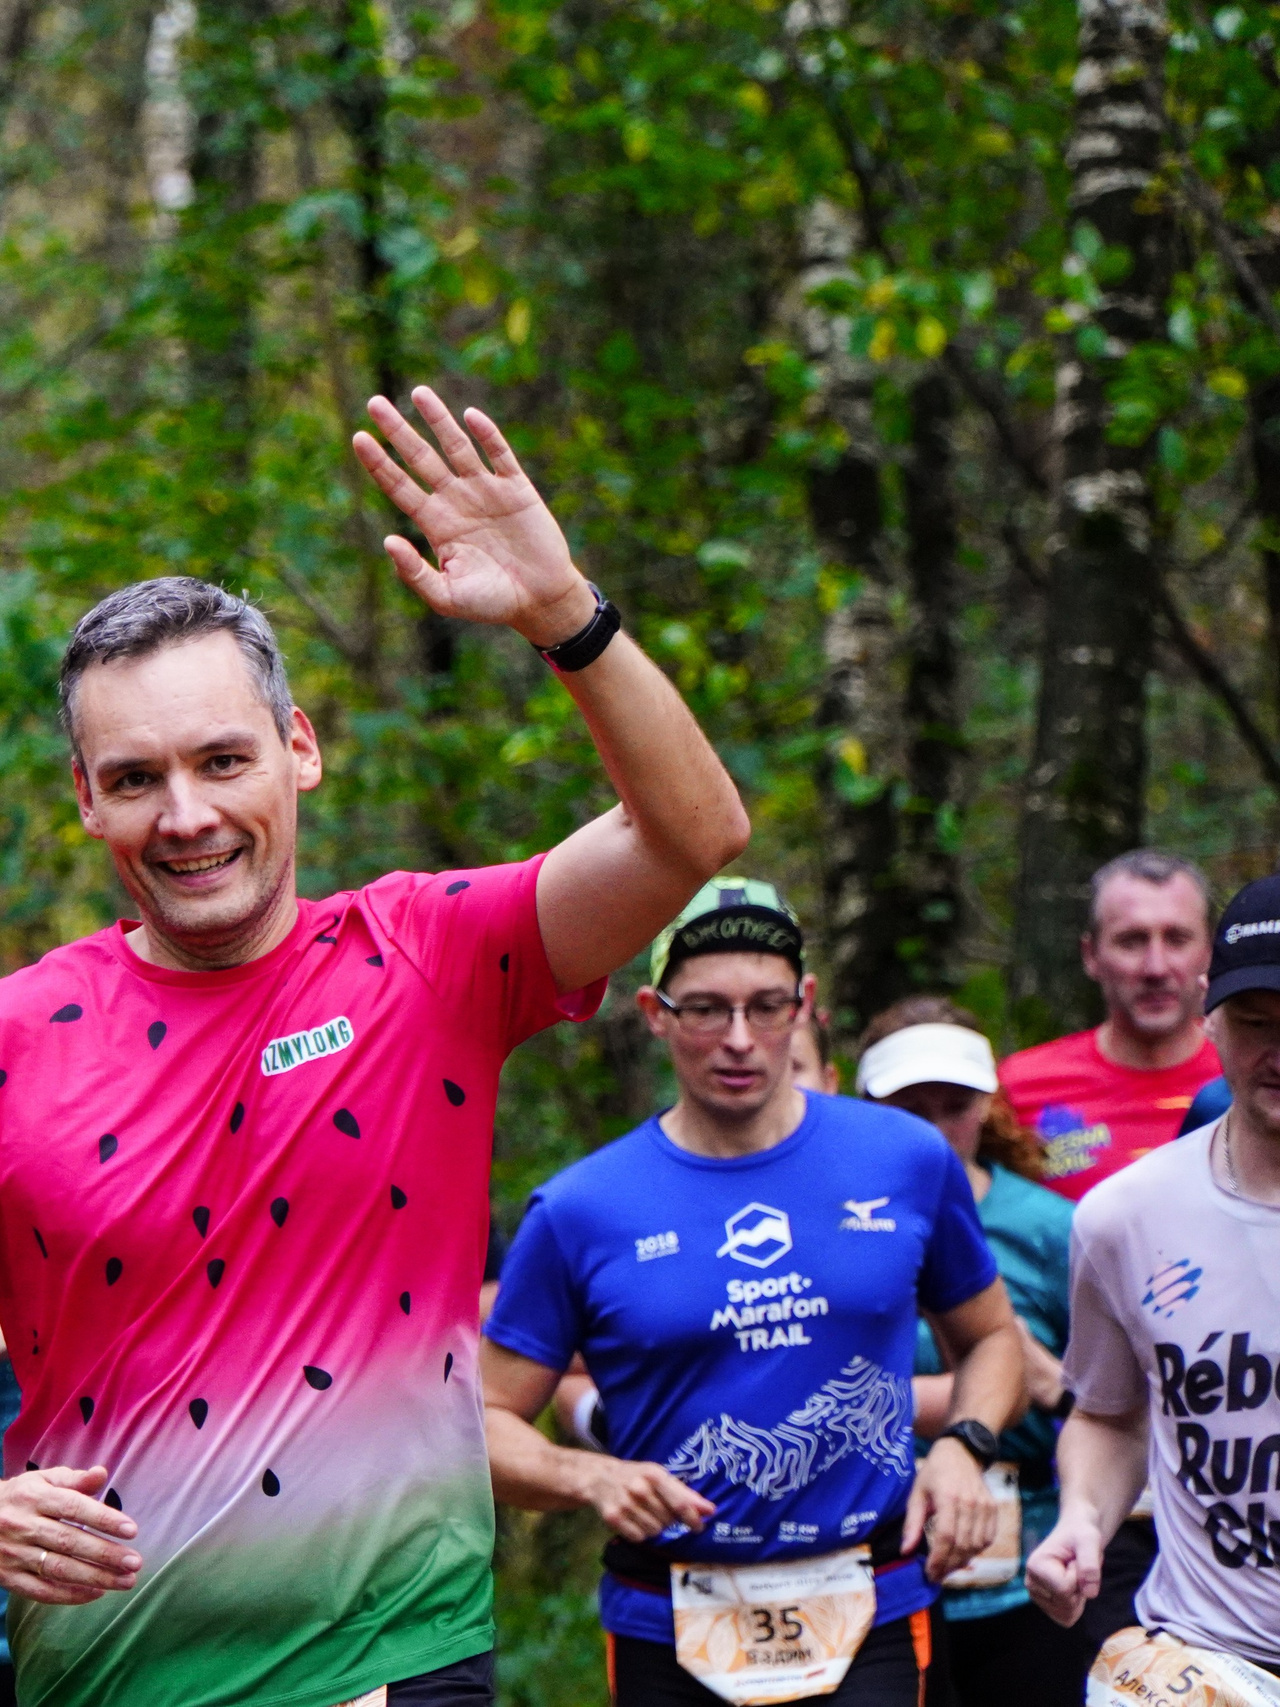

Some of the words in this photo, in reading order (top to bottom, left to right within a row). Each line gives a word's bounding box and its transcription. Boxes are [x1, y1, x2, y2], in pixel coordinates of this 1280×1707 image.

[263, 1019, 352, 1073] IZMYLONG
[709, 1295, 830, 1332] Marafon
[733, 1322, 813, 1354] TRAIL
[1154, 1330, 1280, 1417] Réb
[1204, 1501, 1280, 1569] Cl
[751, 1605, 804, 1643] 35
[1114, 1669, 1174, 1707] Алекс
[1166, 1664, 1205, 1695] 5
